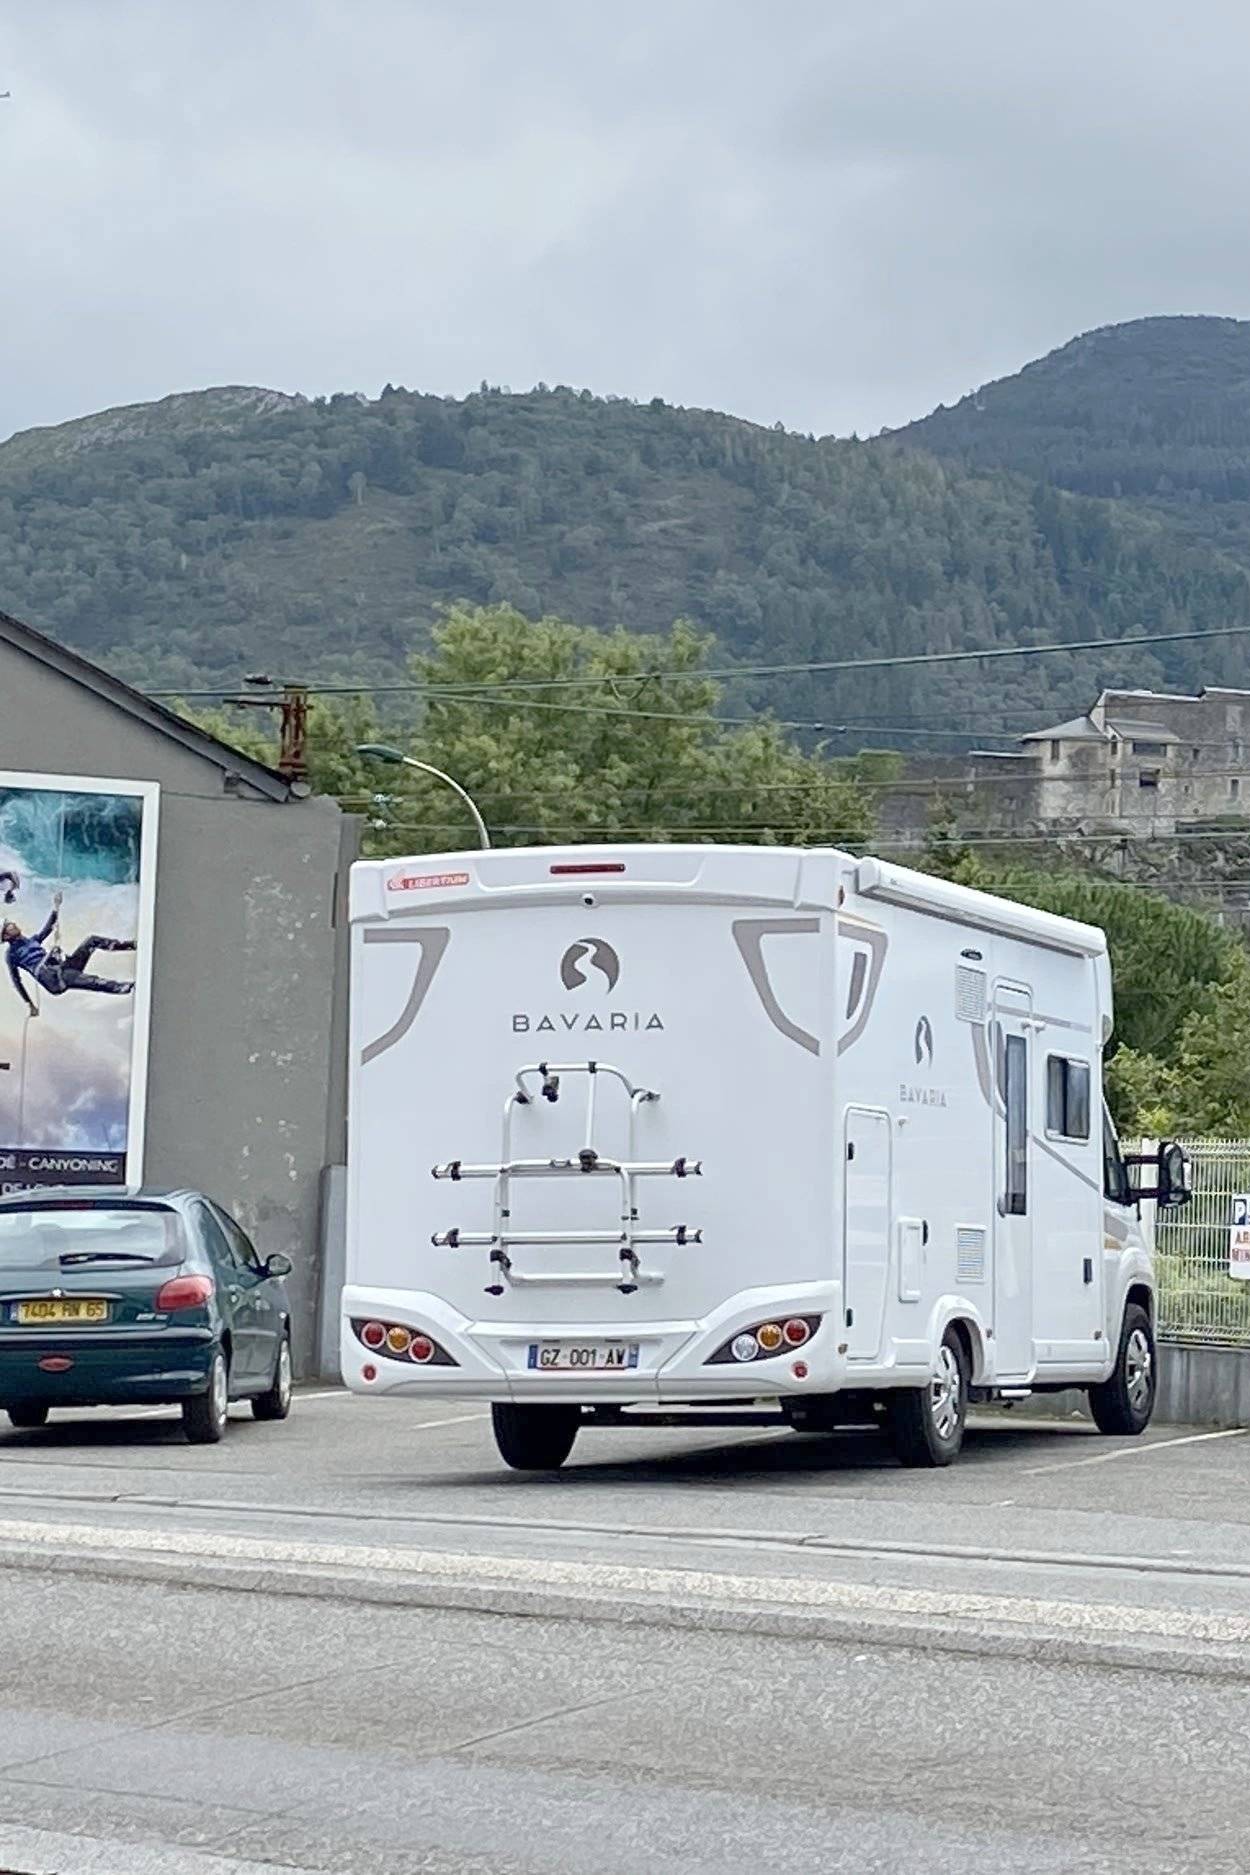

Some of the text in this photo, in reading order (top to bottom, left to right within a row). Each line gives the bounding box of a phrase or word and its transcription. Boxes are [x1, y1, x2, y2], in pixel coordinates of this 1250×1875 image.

[512, 1012, 664, 1032] BAVARIA
[900, 1084, 947, 1107] BAVARIA
[28, 1157, 119, 1173] CANYONING
[86, 1302, 105, 1317] 65
